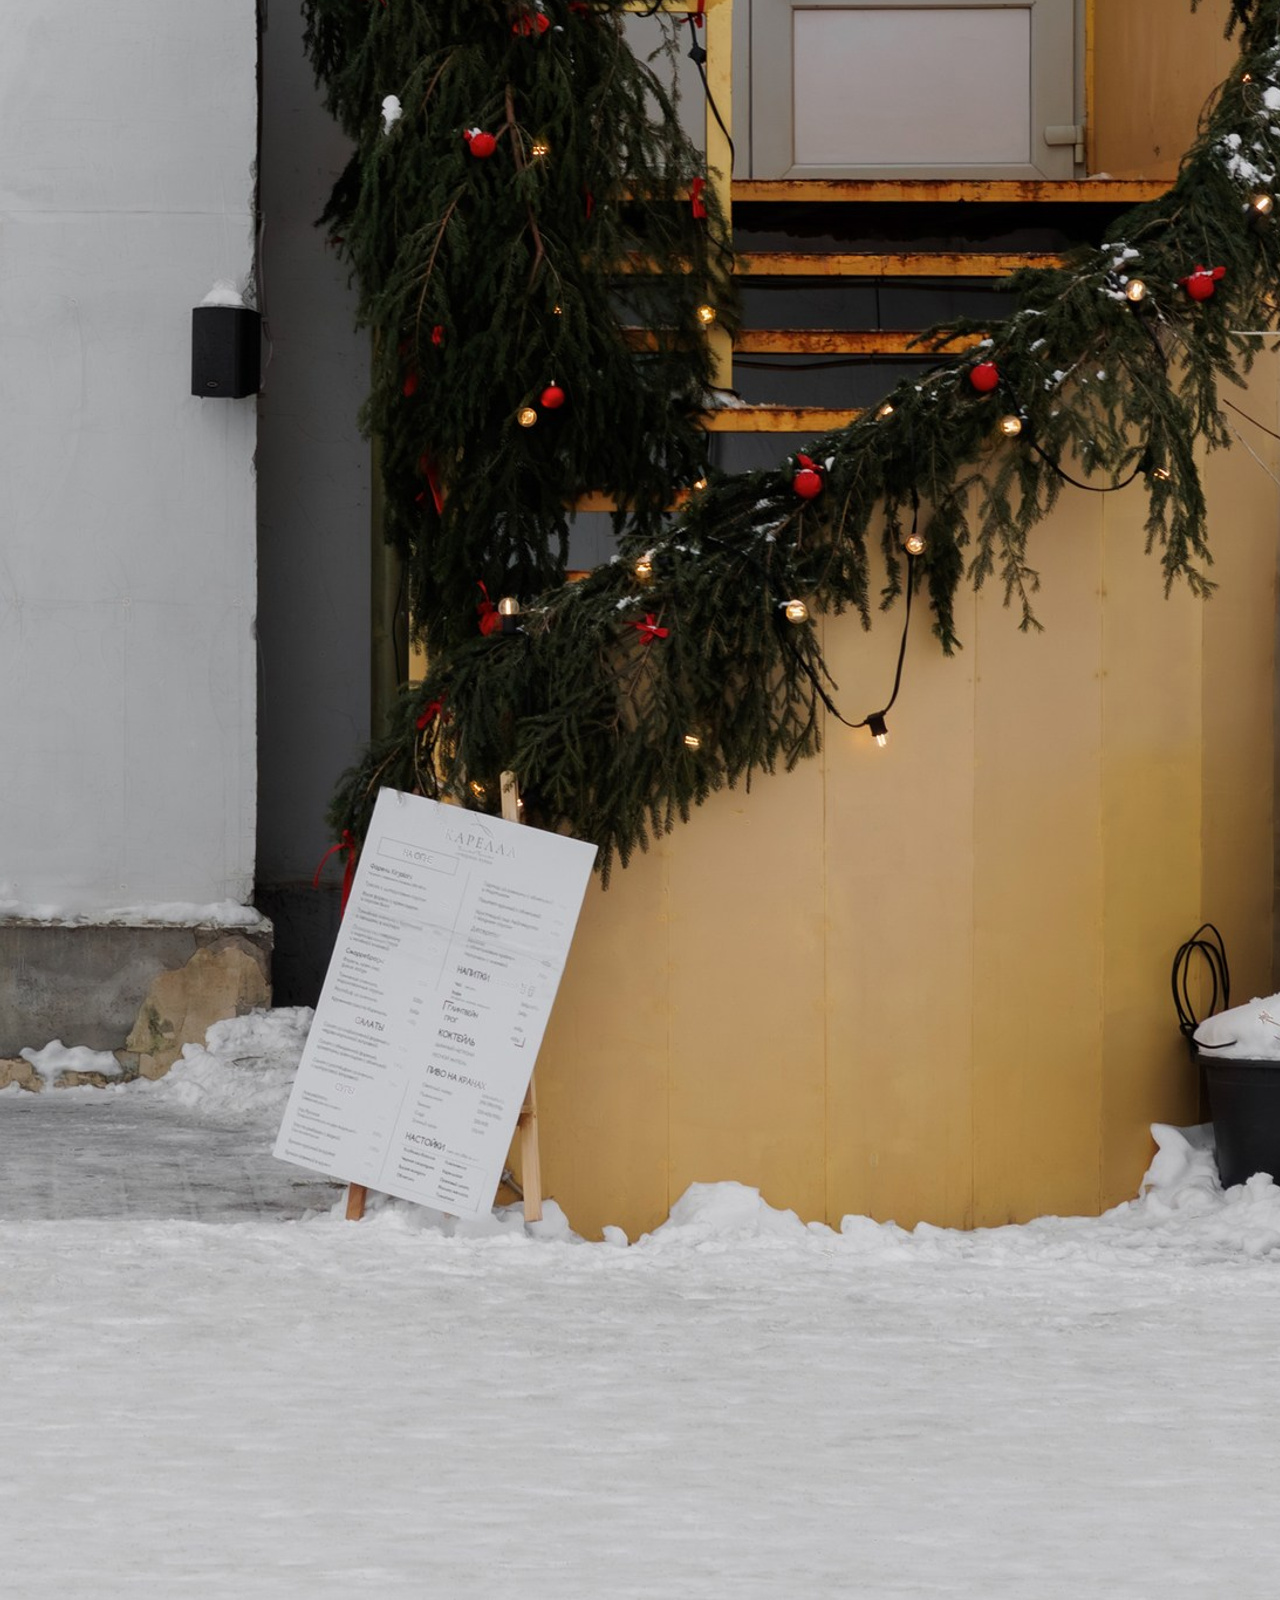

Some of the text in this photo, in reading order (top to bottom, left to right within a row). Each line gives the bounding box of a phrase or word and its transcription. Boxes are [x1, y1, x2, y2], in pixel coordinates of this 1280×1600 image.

[455, 964, 491, 983] НАПИТКИ
[353, 1014, 386, 1032] САЛАТЫ
[436, 1026, 478, 1047] КОКТЕЙЛЬ
[425, 1064, 448, 1079] ПИВО
[446, 1070, 459, 1082] НА
[457, 1073, 488, 1091] КРАНАХ
[404, 1129, 447, 1152] НАСТОЙКИ
